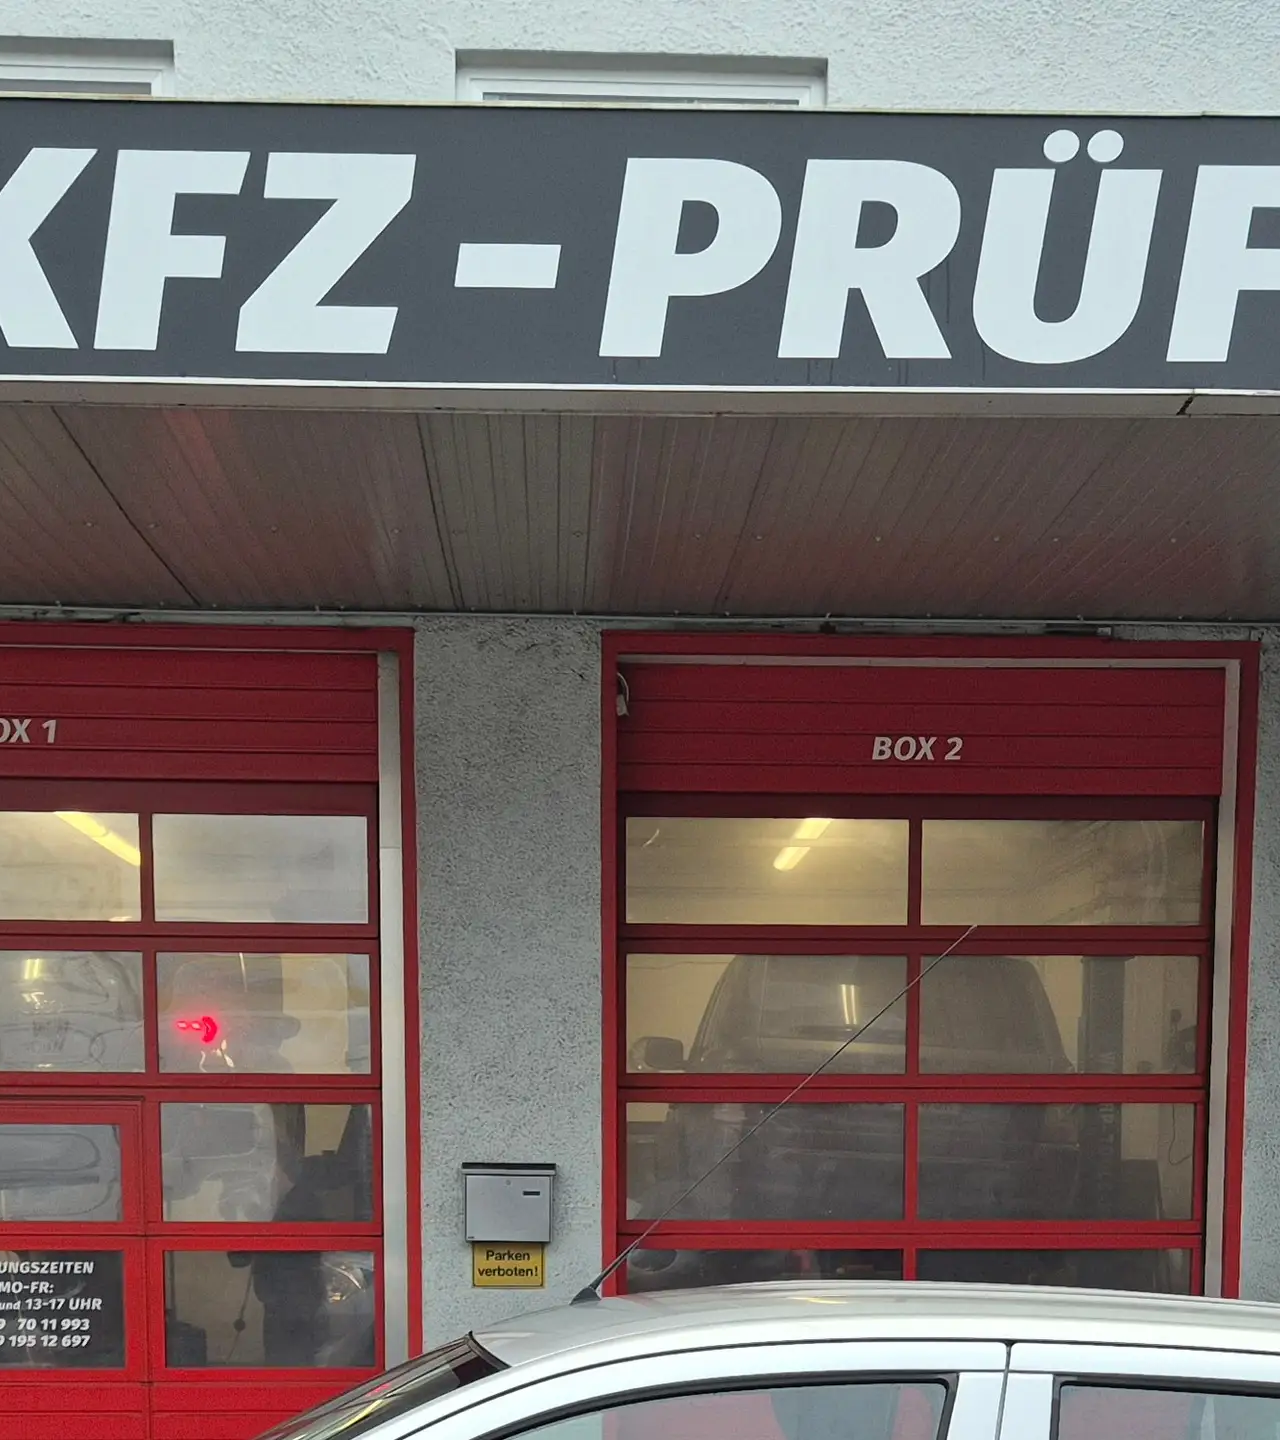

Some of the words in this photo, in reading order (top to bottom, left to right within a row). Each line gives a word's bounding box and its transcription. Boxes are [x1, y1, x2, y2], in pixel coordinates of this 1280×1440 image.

[453, 243, 562, 289] -
[41, 719, 57, 743] 1
[871, 736, 938, 761] BOX
[944, 737, 964, 760] 2
[485, 1249, 531, 1261] Parken
[477, 1265, 539, 1277] verboten!
[24, 1298, 66, 1311] 13-17
[68, 1298, 103, 1311] UHR
[17, 1318, 37, 1331] 70
[40, 1318, 59, 1331] 11
[60, 1318, 91, 1331] 993
[8, 1335, 37, 1348] 195
[40, 1335, 58, 1348] 12
[61, 1335, 91, 1348] 697
